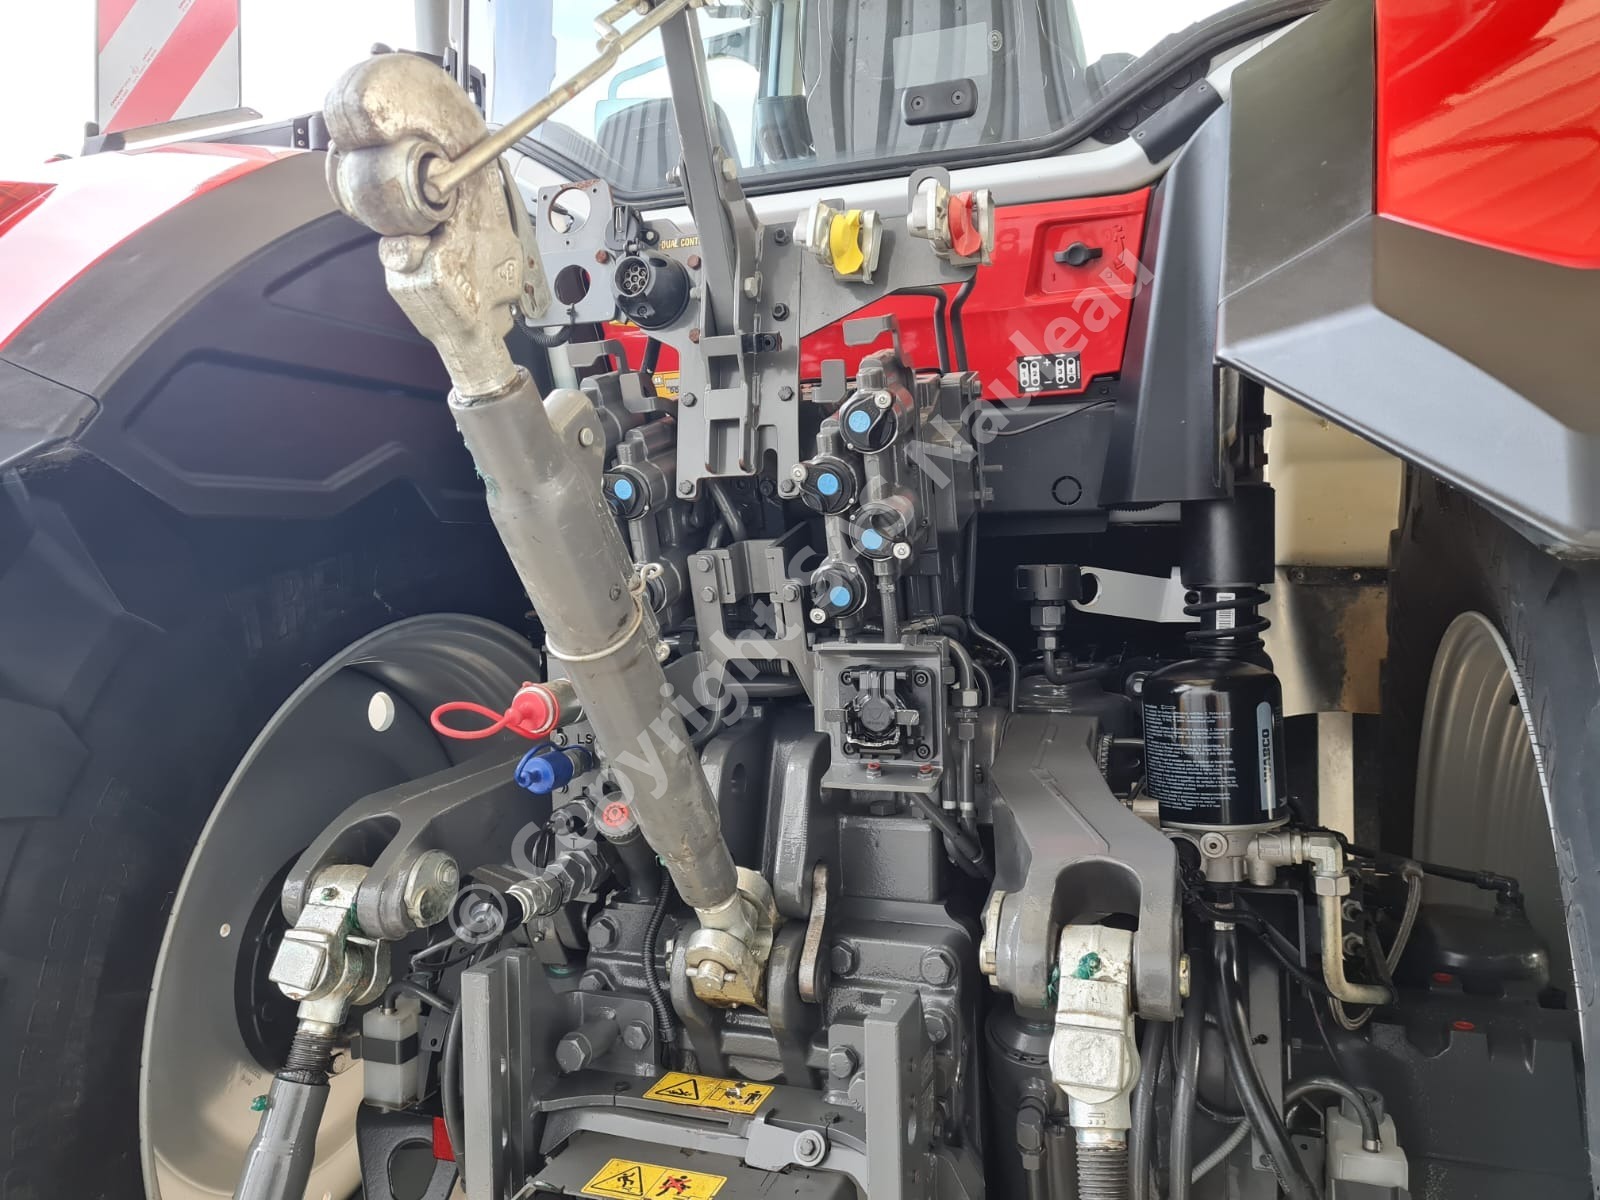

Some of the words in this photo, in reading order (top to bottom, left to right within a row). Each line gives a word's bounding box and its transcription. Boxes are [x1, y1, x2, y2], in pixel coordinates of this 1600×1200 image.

[660, 238, 678, 249] DUAL
[680, 236, 699, 247] CONT
[577, 734, 593, 745] LS
[1262, 729, 1271, 783] WABCO
